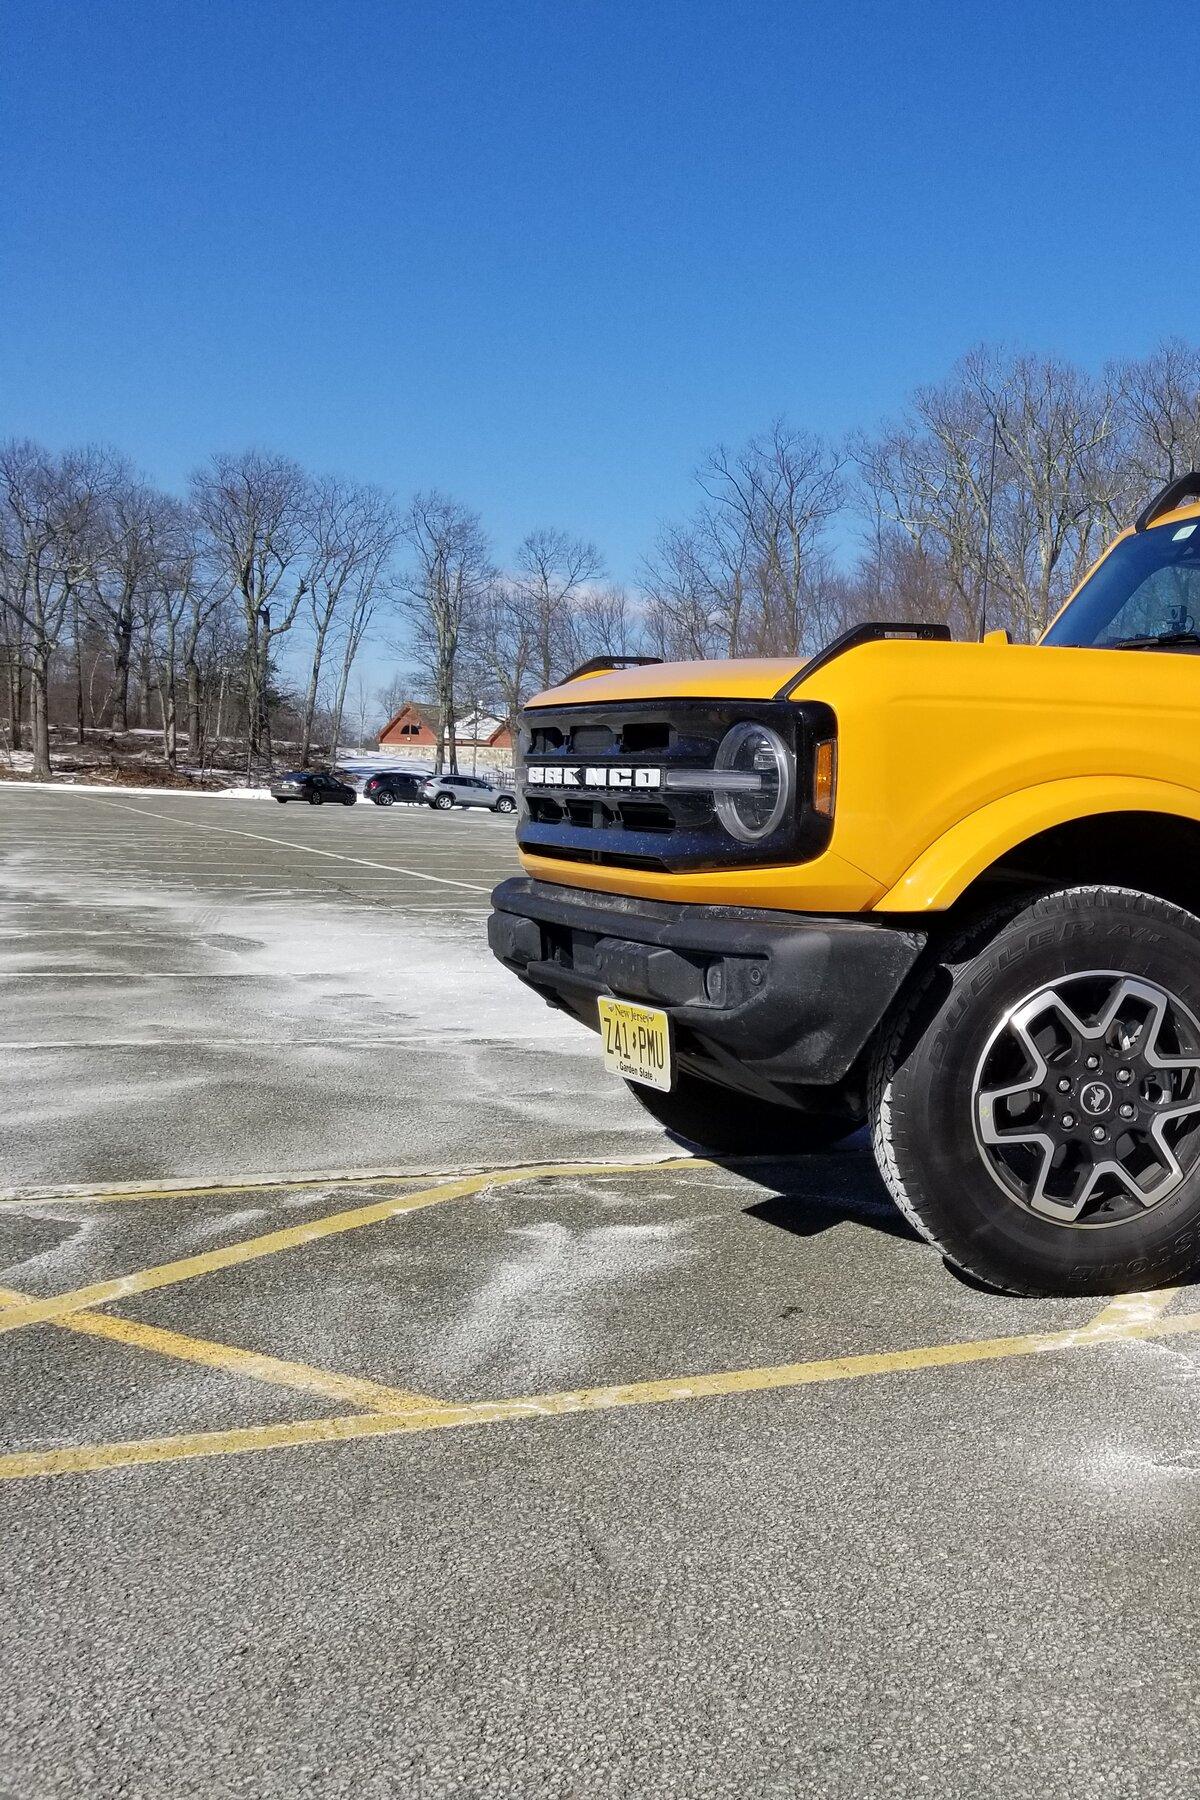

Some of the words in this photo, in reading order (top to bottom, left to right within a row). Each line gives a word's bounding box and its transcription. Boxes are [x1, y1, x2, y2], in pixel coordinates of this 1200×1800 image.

[615, 1004, 630, 1017] New
[630, 1008, 650, 1024] Jersey
[604, 1017, 630, 1059] Z41
[638, 1026, 664, 1069] PMU
[620, 1061, 638, 1074] Garden
[640, 1067, 653, 1080] State
